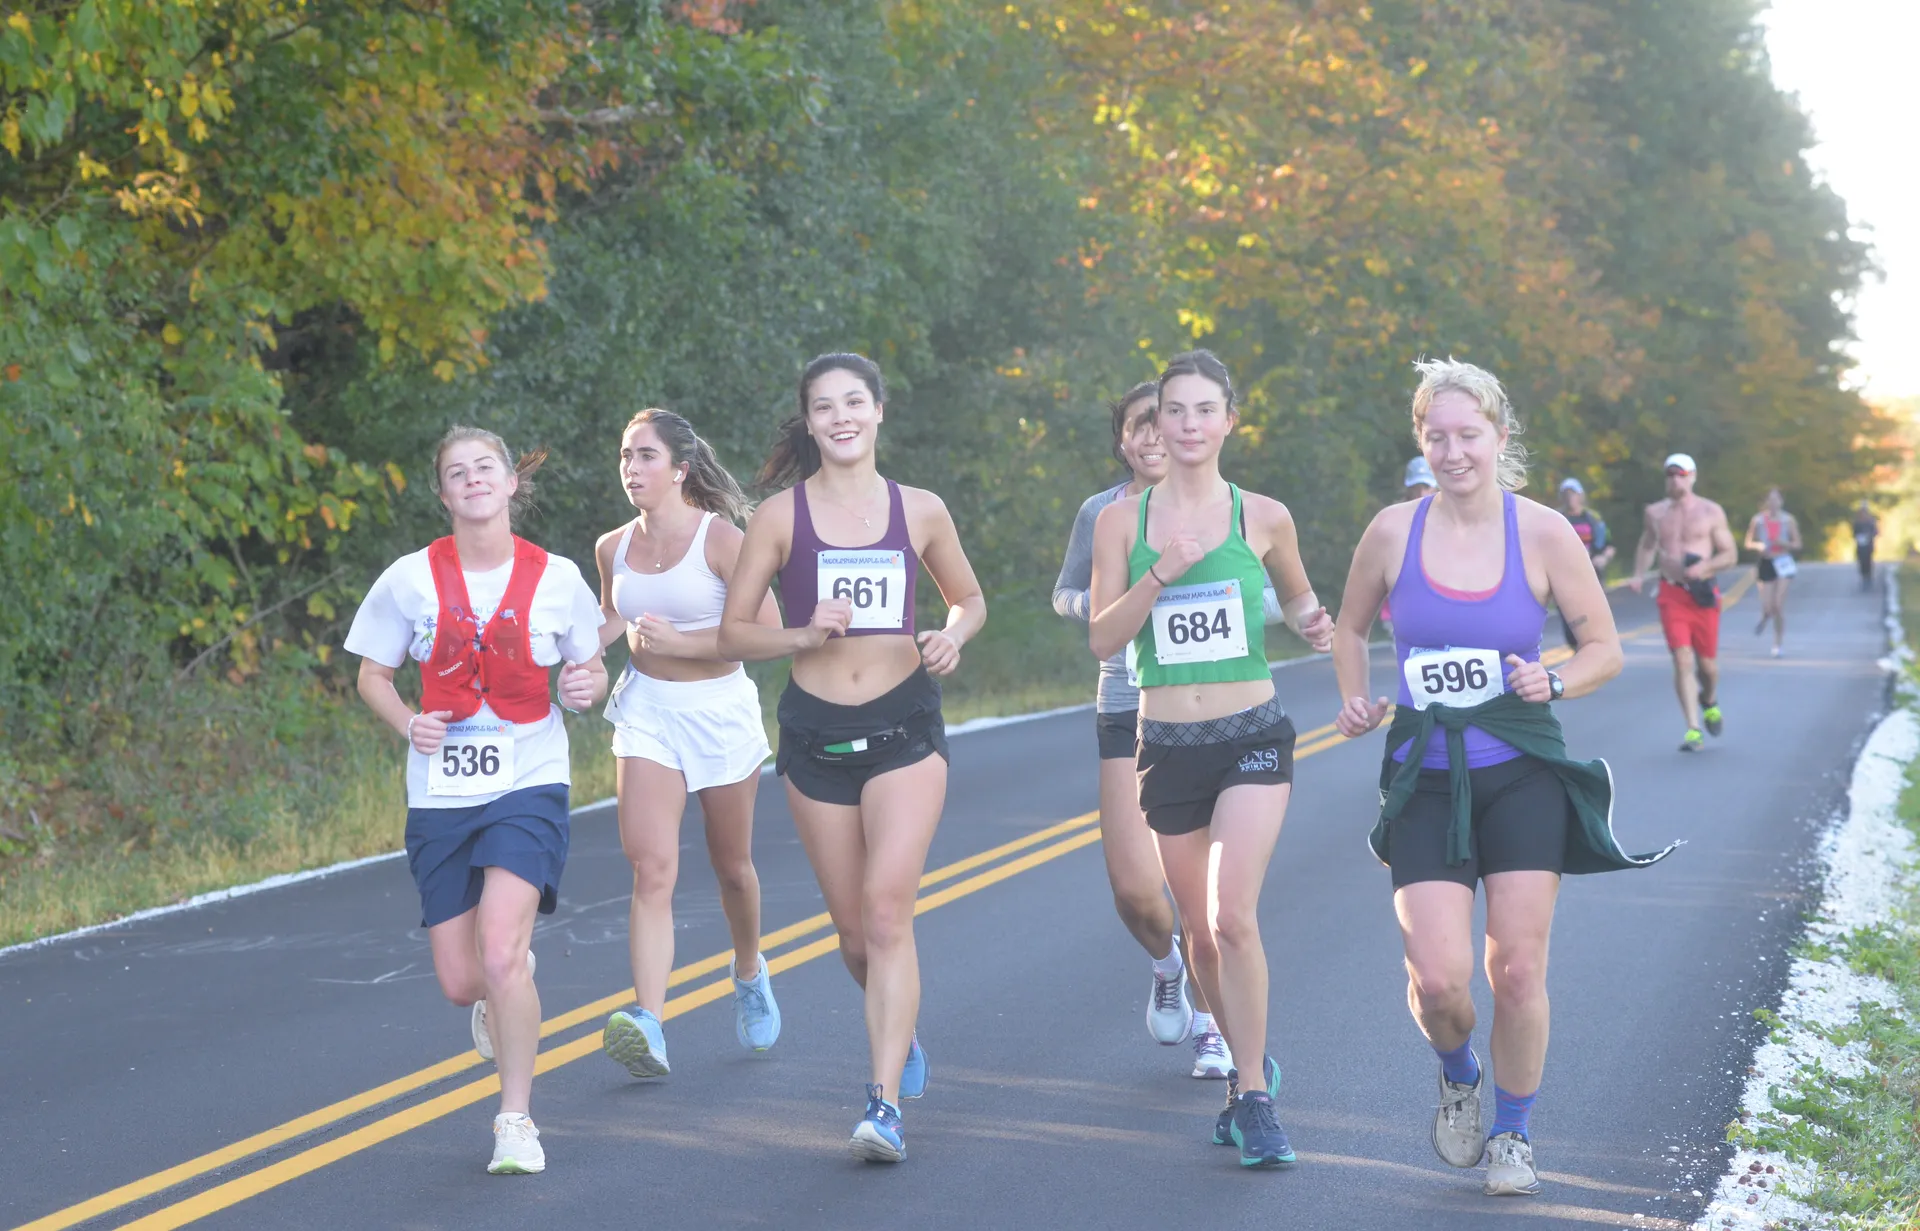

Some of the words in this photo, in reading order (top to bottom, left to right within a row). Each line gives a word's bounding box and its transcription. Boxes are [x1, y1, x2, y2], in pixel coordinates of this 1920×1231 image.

[832, 576, 888, 609] 661
[1167, 607, 1232, 645] 684
[1421, 658, 1488, 695] 596
[442, 744, 500, 777] 536
